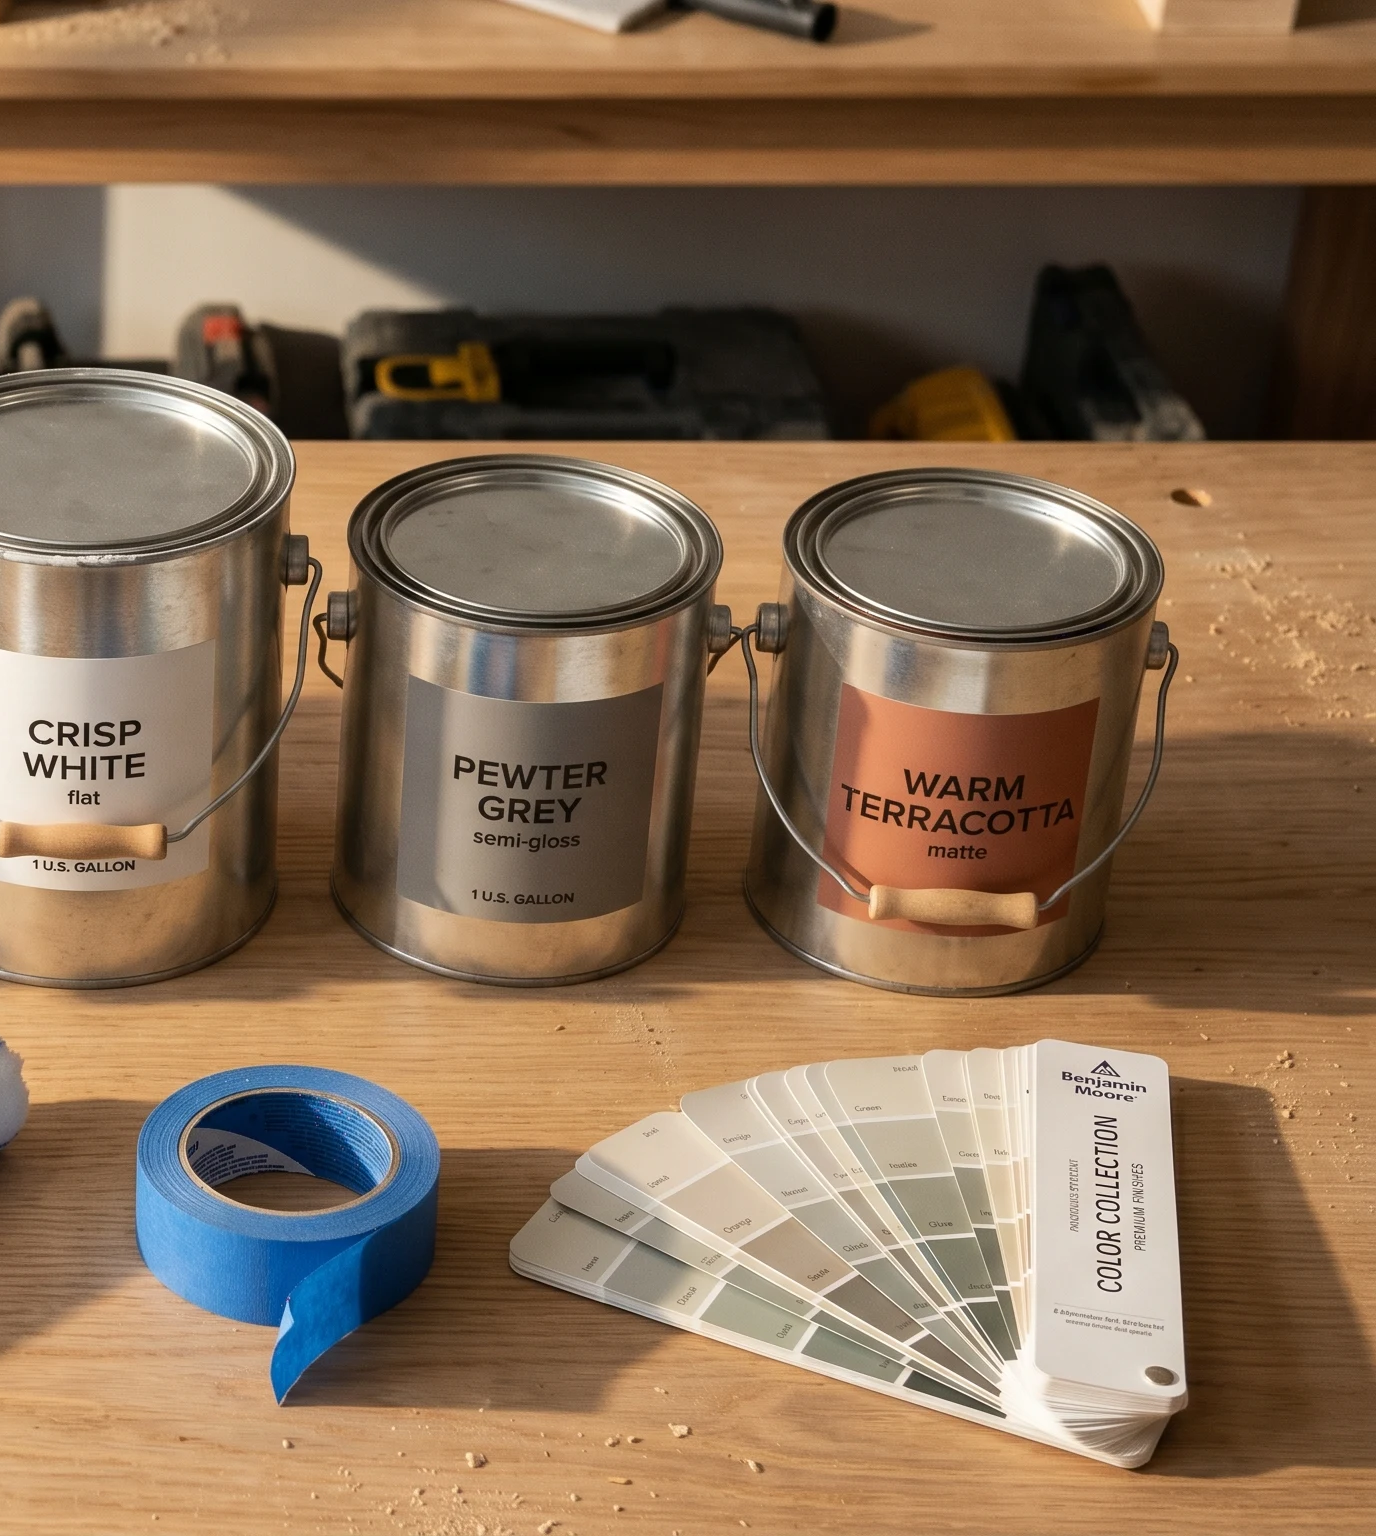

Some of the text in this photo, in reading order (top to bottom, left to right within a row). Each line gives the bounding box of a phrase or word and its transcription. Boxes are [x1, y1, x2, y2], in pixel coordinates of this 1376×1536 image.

[28, 719, 142, 748] CRISP
[22, 751, 146, 781] WHITE
[453, 754, 608, 790] PEWTER
[903, 768, 1026, 802] WARM
[67, 790, 101, 806] flat
[478, 795, 582, 824] GREY
[840, 783, 1074, 836] TERRACOTTA
[473, 831, 581, 853] semi-gloss
[927, 845, 988, 860] matte
[32, 859, 135, 872] 1 U.S. GALLON
[471, 889, 575, 905] 1 U.S. GALLON
[1061, 1071, 1147, 1093] Benjamin
[1074, 1085, 1135, 1103] Moore
[1093, 1114, 1123, 1293] COLOR COLLECTION
